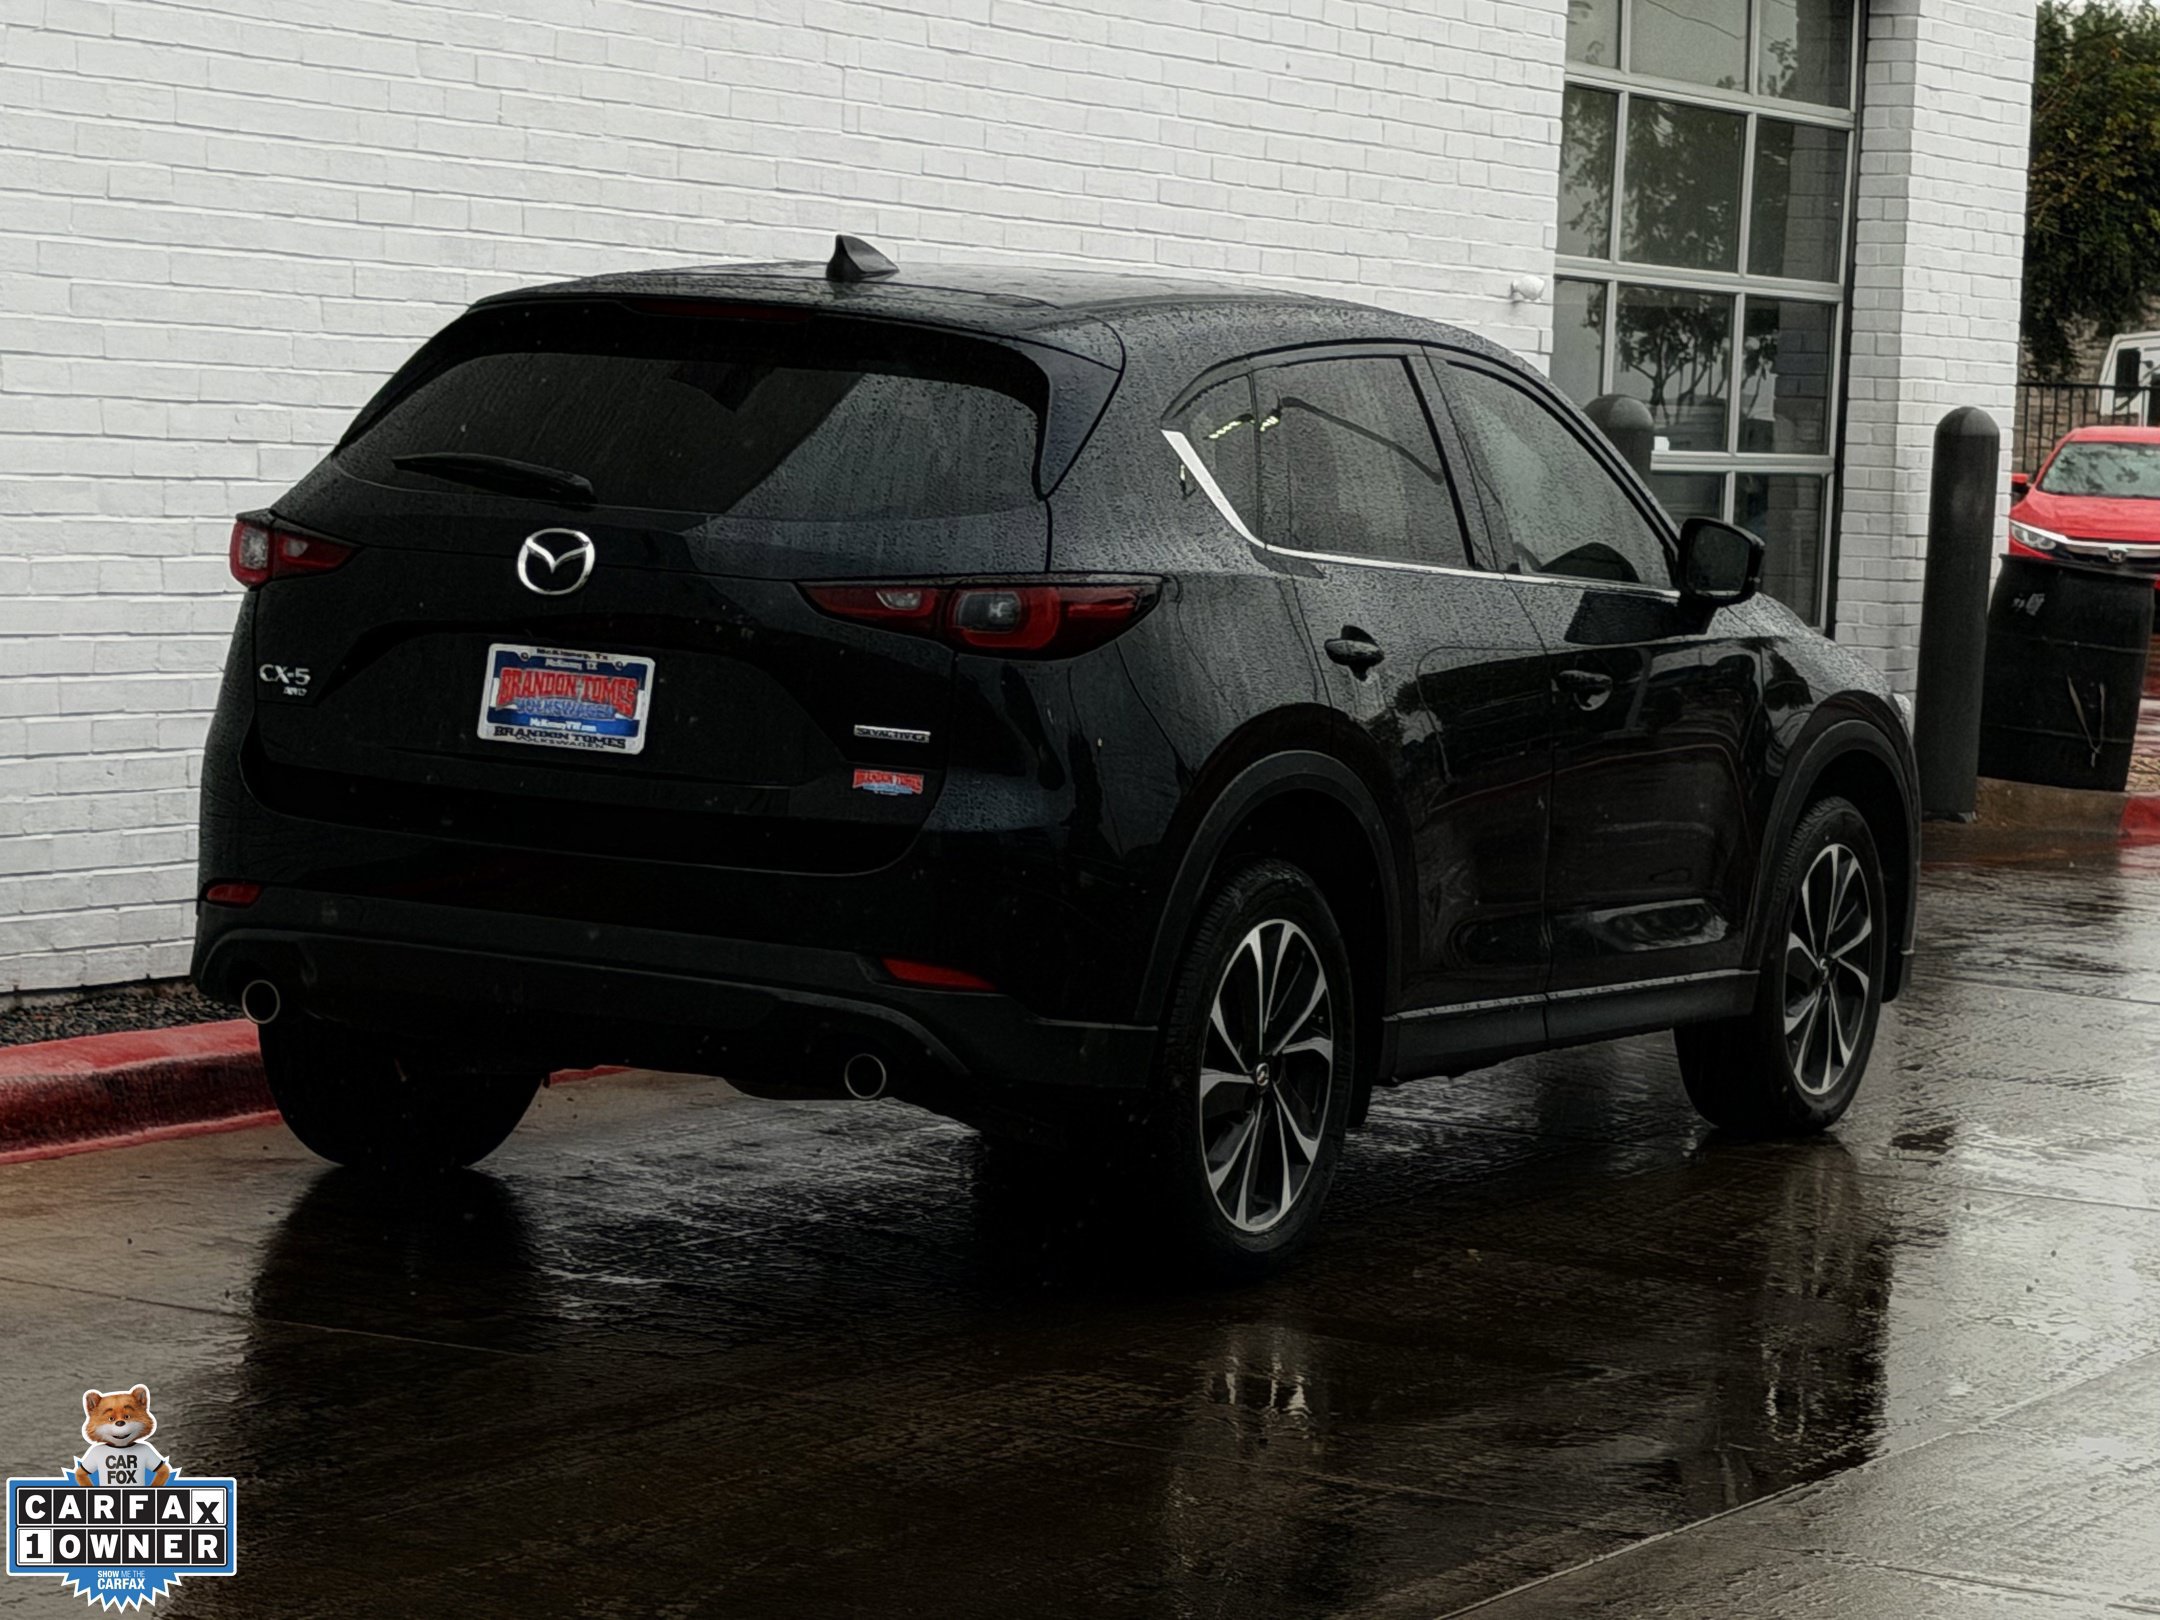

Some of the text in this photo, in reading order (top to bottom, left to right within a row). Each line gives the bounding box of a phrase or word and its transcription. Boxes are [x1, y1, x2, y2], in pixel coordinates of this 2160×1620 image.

[259, 663, 311, 686] CX-5
[496, 667, 640, 719] BRANDON TOMES
[494, 726, 626, 749] BRANDON TOMES
